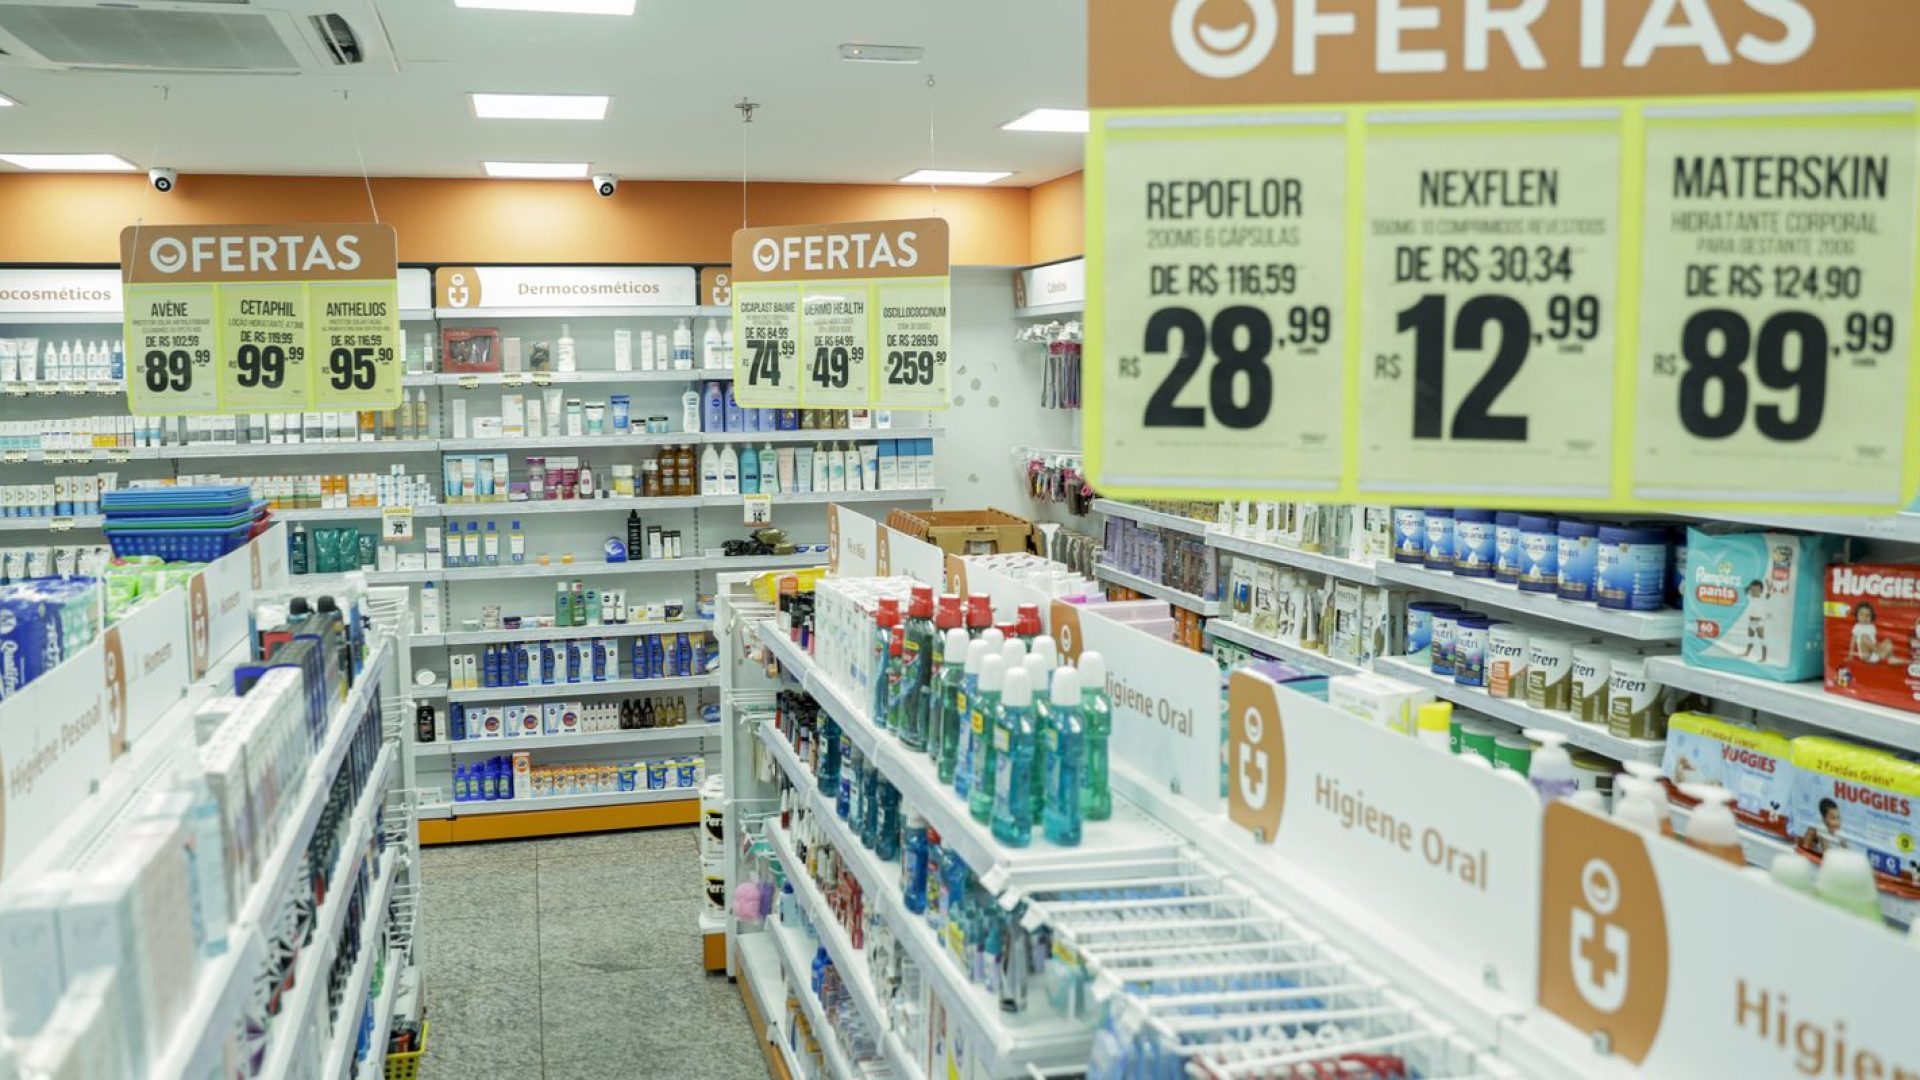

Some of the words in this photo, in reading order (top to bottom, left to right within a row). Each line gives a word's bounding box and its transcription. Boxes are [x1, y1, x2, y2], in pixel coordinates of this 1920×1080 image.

[1420, 169, 1558, 207] NEXFLEN
[1673, 155, 1888, 200] MATERSKIN
[1147, 178, 1302, 220] REPOFLOR
[1672, 210, 1779, 232] HIDRATANTE
[1785, 210, 1879, 234] CORPORAL
[1147, 229, 1200, 249] 200MG
[1204, 228, 1215, 248] 6
[1697, 237, 1735, 255] PARA
[150, 234, 361, 273] OFERTAS
[752, 231, 918, 272] OFERTAS
[1396, 246, 1431, 283] DE
[1442, 246, 1479, 284] R$
[1489, 246, 1572, 285] 30,34
[518, 282, 660, 296] Dermocosméticos
[1150, 265, 1179, 295] DE
[1188, 264, 1219, 296] R$
[1227, 264, 1296, 297] 116,59
[1686, 265, 1718, 298] DE
[1729, 264, 1763, 298] R$
[1774, 265, 1861, 301] 124,90
[241, 299, 296, 317] CETAPHIL
[326, 302, 386, 317] ANTHELIOS
[833, 302, 864, 315] HEALTH
[146, 336, 156, 347] DE
[240, 331, 251, 342] DE
[331, 335, 342, 346] DE
[745, 327, 754, 339] DE
[814, 336, 824, 346] DE
[887, 334, 897, 347] DE
[1119, 357, 1140, 378] R$
[1375, 354, 1402, 379] R$
[1653, 354, 1677, 376] R$
[1158, 697, 1193, 737] Oral
[1834, 781, 1911, 817] HUGGIES
[1315, 773, 1412, 852] Higiene
[1422, 826, 1488, 891] Oral
